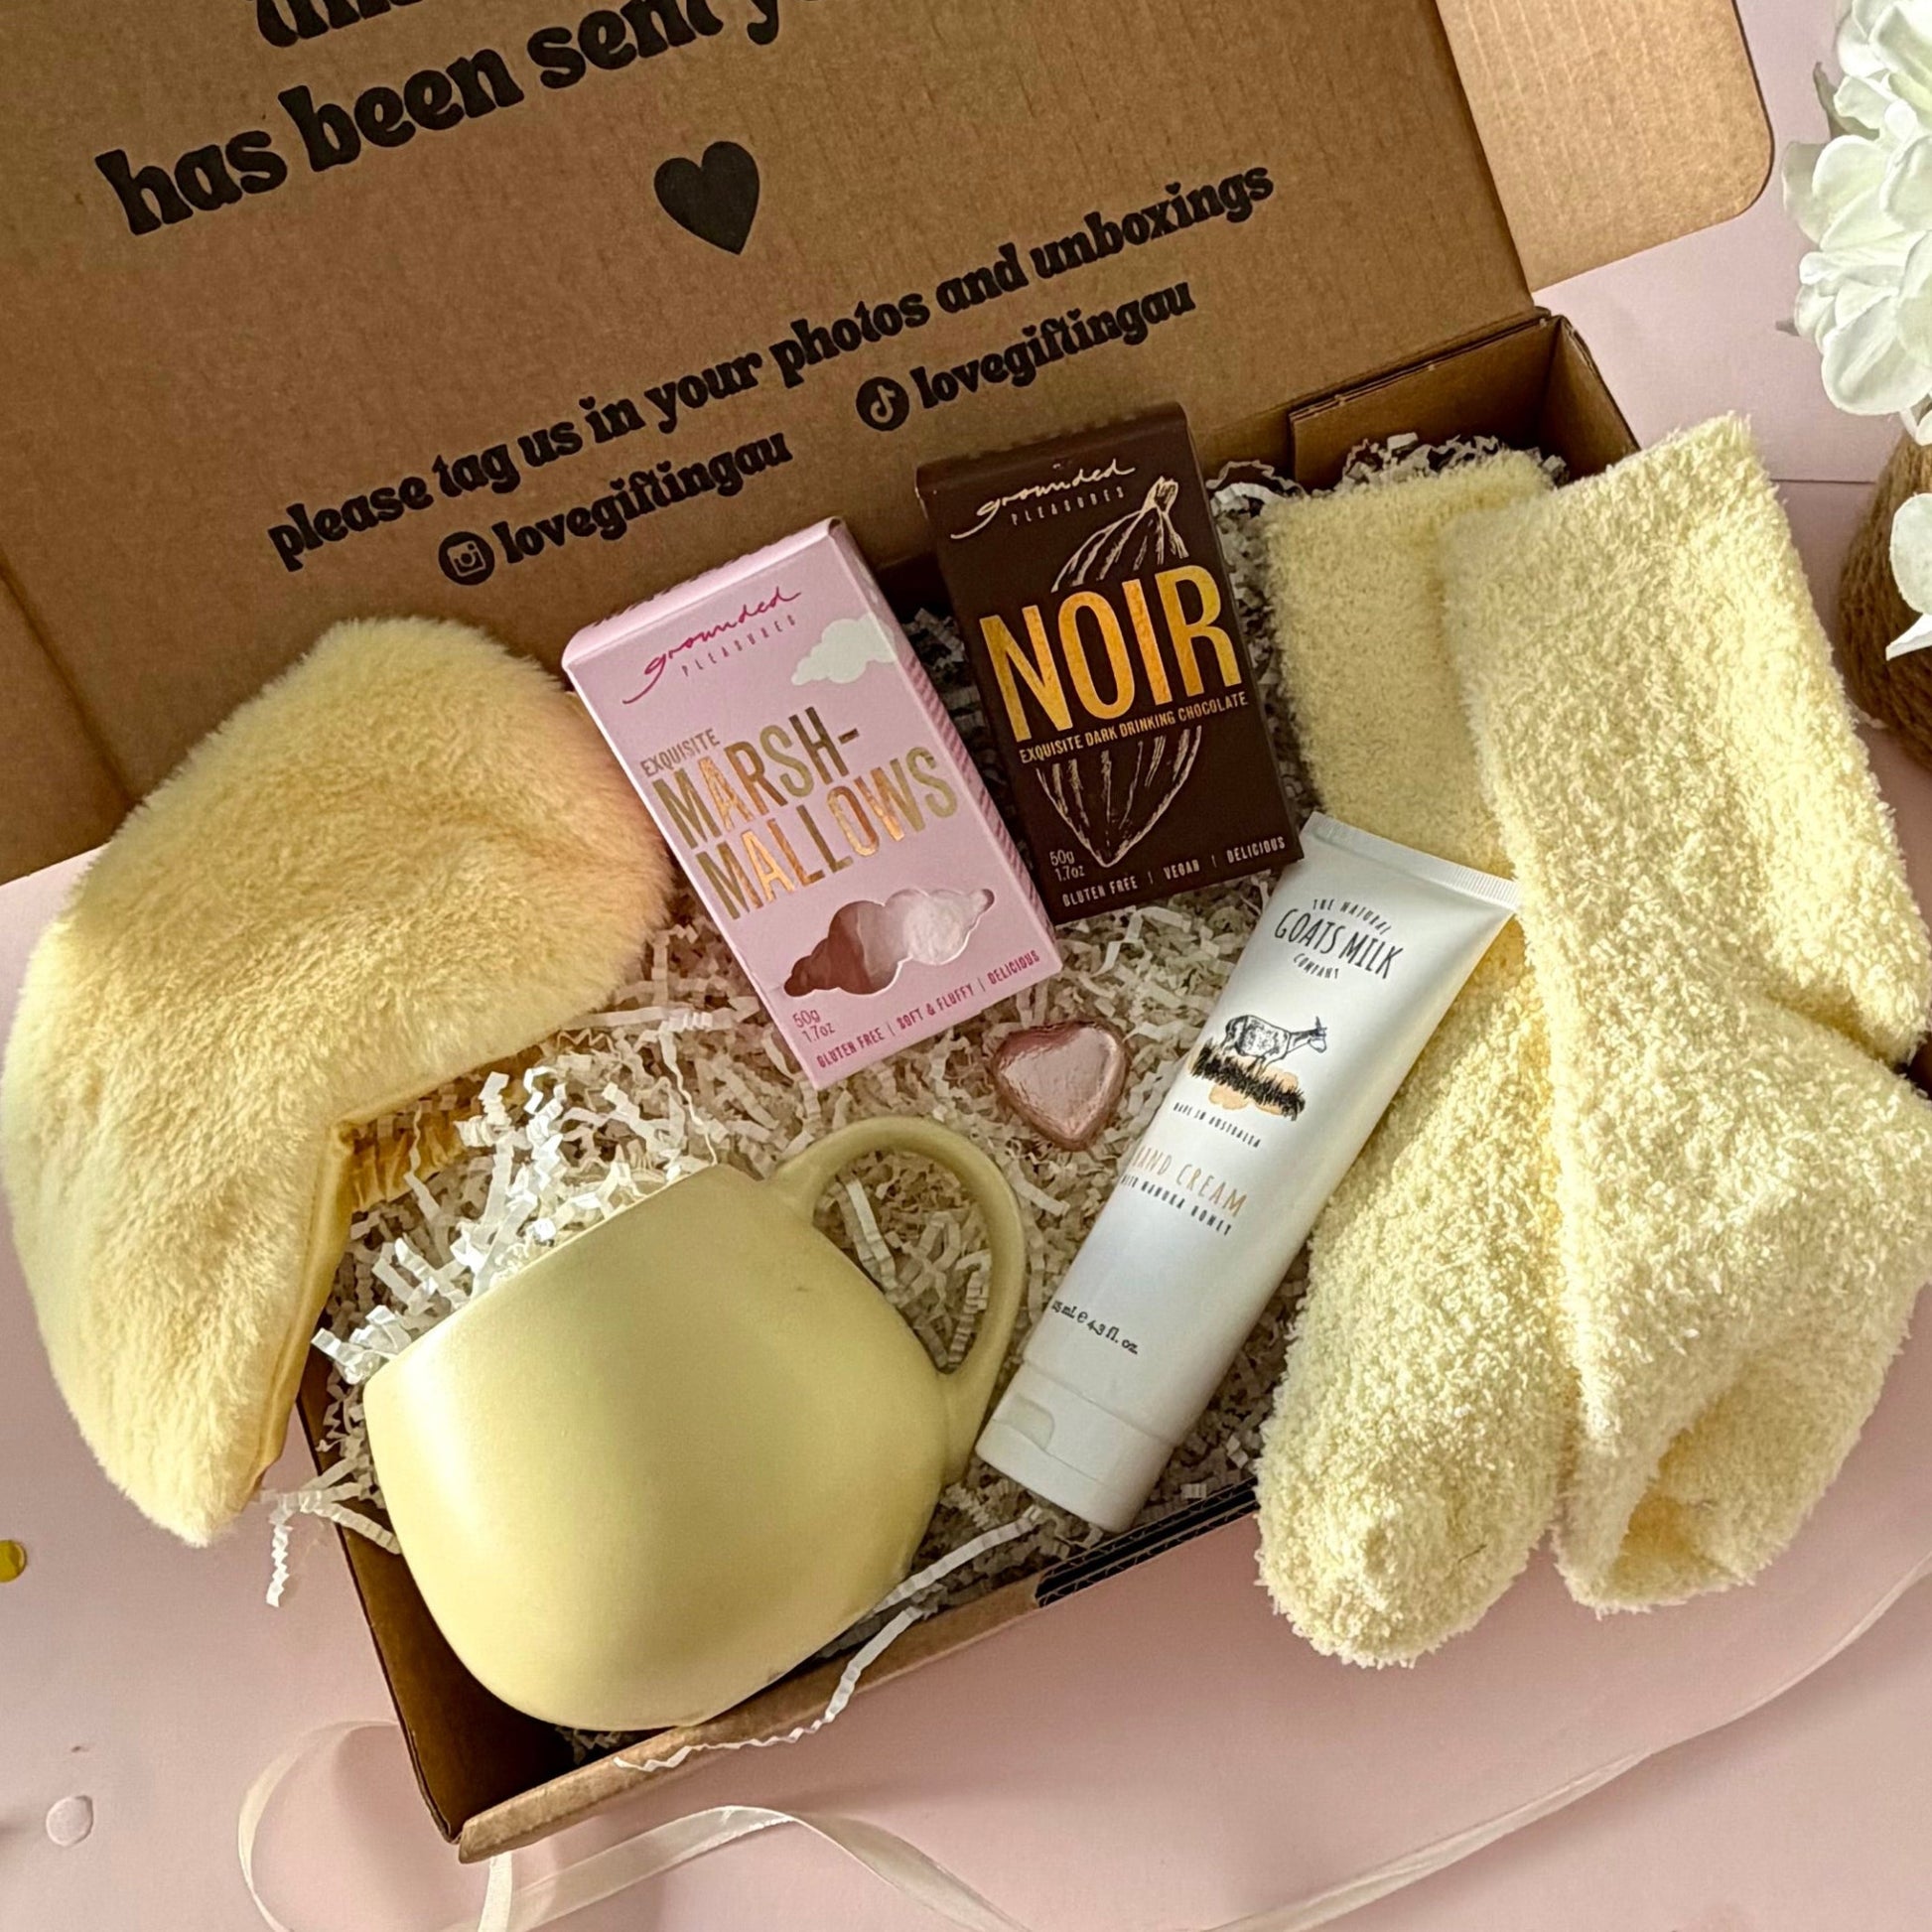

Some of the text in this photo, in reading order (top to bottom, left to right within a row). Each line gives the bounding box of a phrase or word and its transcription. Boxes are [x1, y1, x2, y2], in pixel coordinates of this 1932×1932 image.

[95, 130, 288, 235] has
[279, 49, 524, 172] been
[268, 167, 1274, 572] please tag us in your photos and unboxings
[909, 282, 1195, 409] lovegiftingau
[491, 433, 793, 563] lovegiftingau
[950, 459, 1136, 539] grounded
[1011, 486, 1124, 525] PLEASURES
[622, 586, 801, 704] grounded
[980, 565, 1242, 743] NOIR
[639, 728, 720, 777] EXQUISITE
[1019, 691, 1248, 763] EXQUISITE DARK DRINKING CHOCOLATE
[652, 706, 860, 849] MARSH-
[696, 747, 958, 920] MALLOWS
[1049, 850, 1075, 866] 50g
[1062, 836, 1286, 907] GLUTEN FREE VEGAN DELICIOUS
[1054, 864, 1085, 882] 1.7oz
[1274, 908, 1404, 980] GOATS MILK
[792, 1009, 821, 1029] 50g
[801, 1022, 836, 1043] 1.7oz
[817, 1039, 858, 1068] GLUTEN
[857, 1028, 885, 1049] FREE
[897, 1009, 924, 1031] SOFT
[936, 988, 975, 1012] FLUFFY
[987, 949, 1040, 985] DELICIOUS
[1175, 1164, 1247, 1217] CREAM
